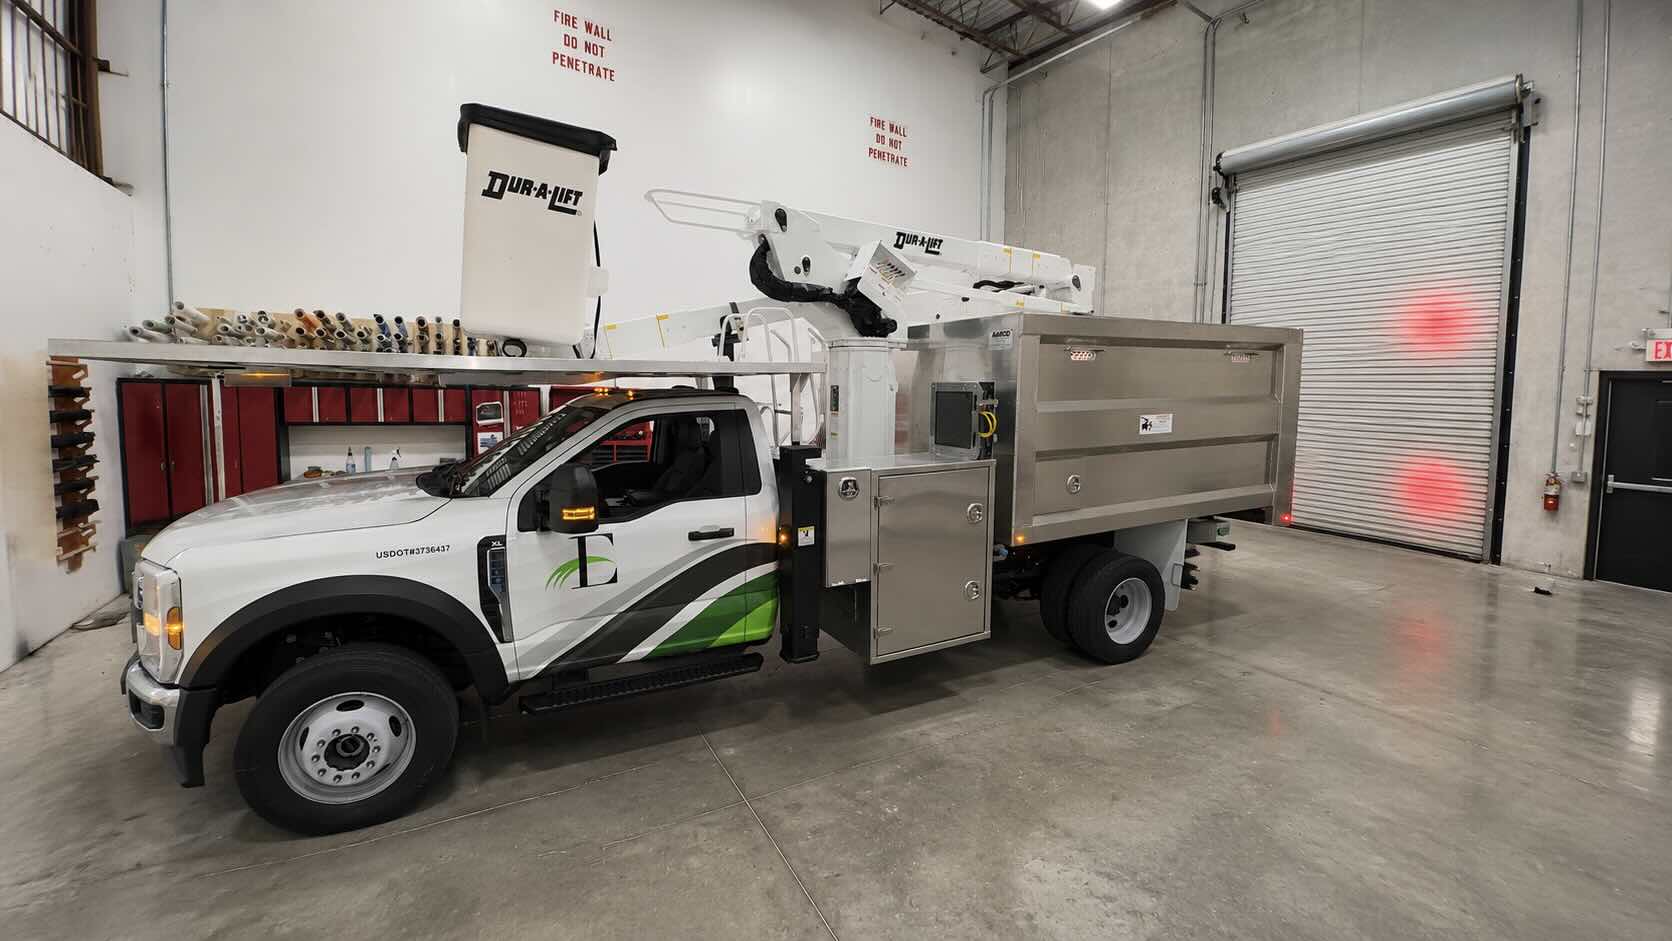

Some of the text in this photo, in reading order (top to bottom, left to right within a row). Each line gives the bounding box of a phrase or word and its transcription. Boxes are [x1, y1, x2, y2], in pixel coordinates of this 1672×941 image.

[554, 10, 612, 41] FIRE WALL
[563, 34, 605, 58] DO NOT
[552, 51, 615, 81] PENETRATE
[870, 116, 907, 137] FIRE WALL
[876, 133, 902, 151] DO NOT
[868, 147, 908, 167] PENETRATE
[376, 544, 451, 559] USDOT#3736437
